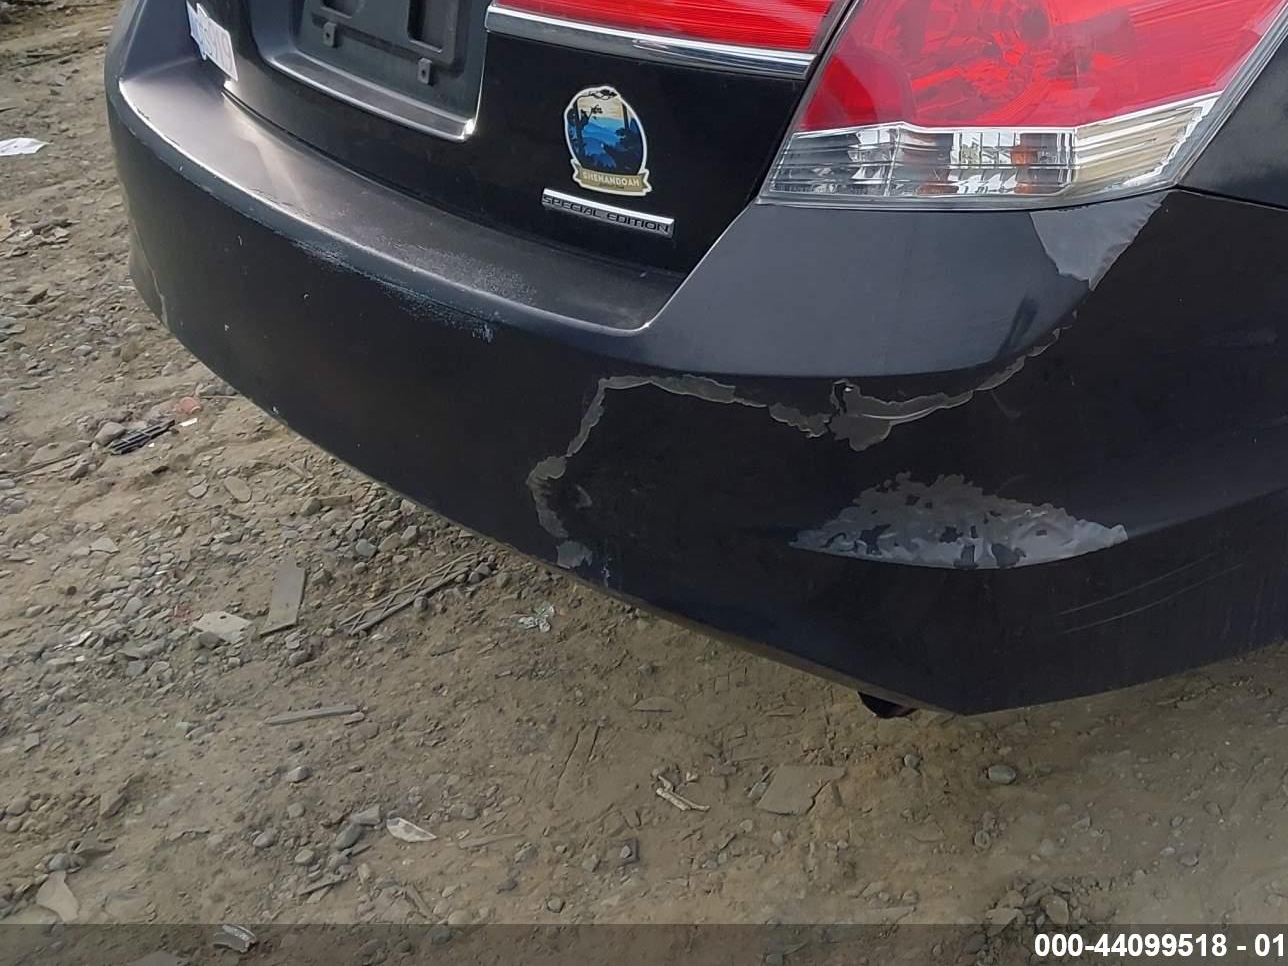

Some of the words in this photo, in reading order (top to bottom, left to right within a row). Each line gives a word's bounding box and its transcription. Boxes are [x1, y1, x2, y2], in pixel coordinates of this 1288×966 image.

[582, 170, 640, 187] SHENANDOAH
[542, 194, 602, 218] SPECIAL
[606, 211, 670, 233] EDITION
